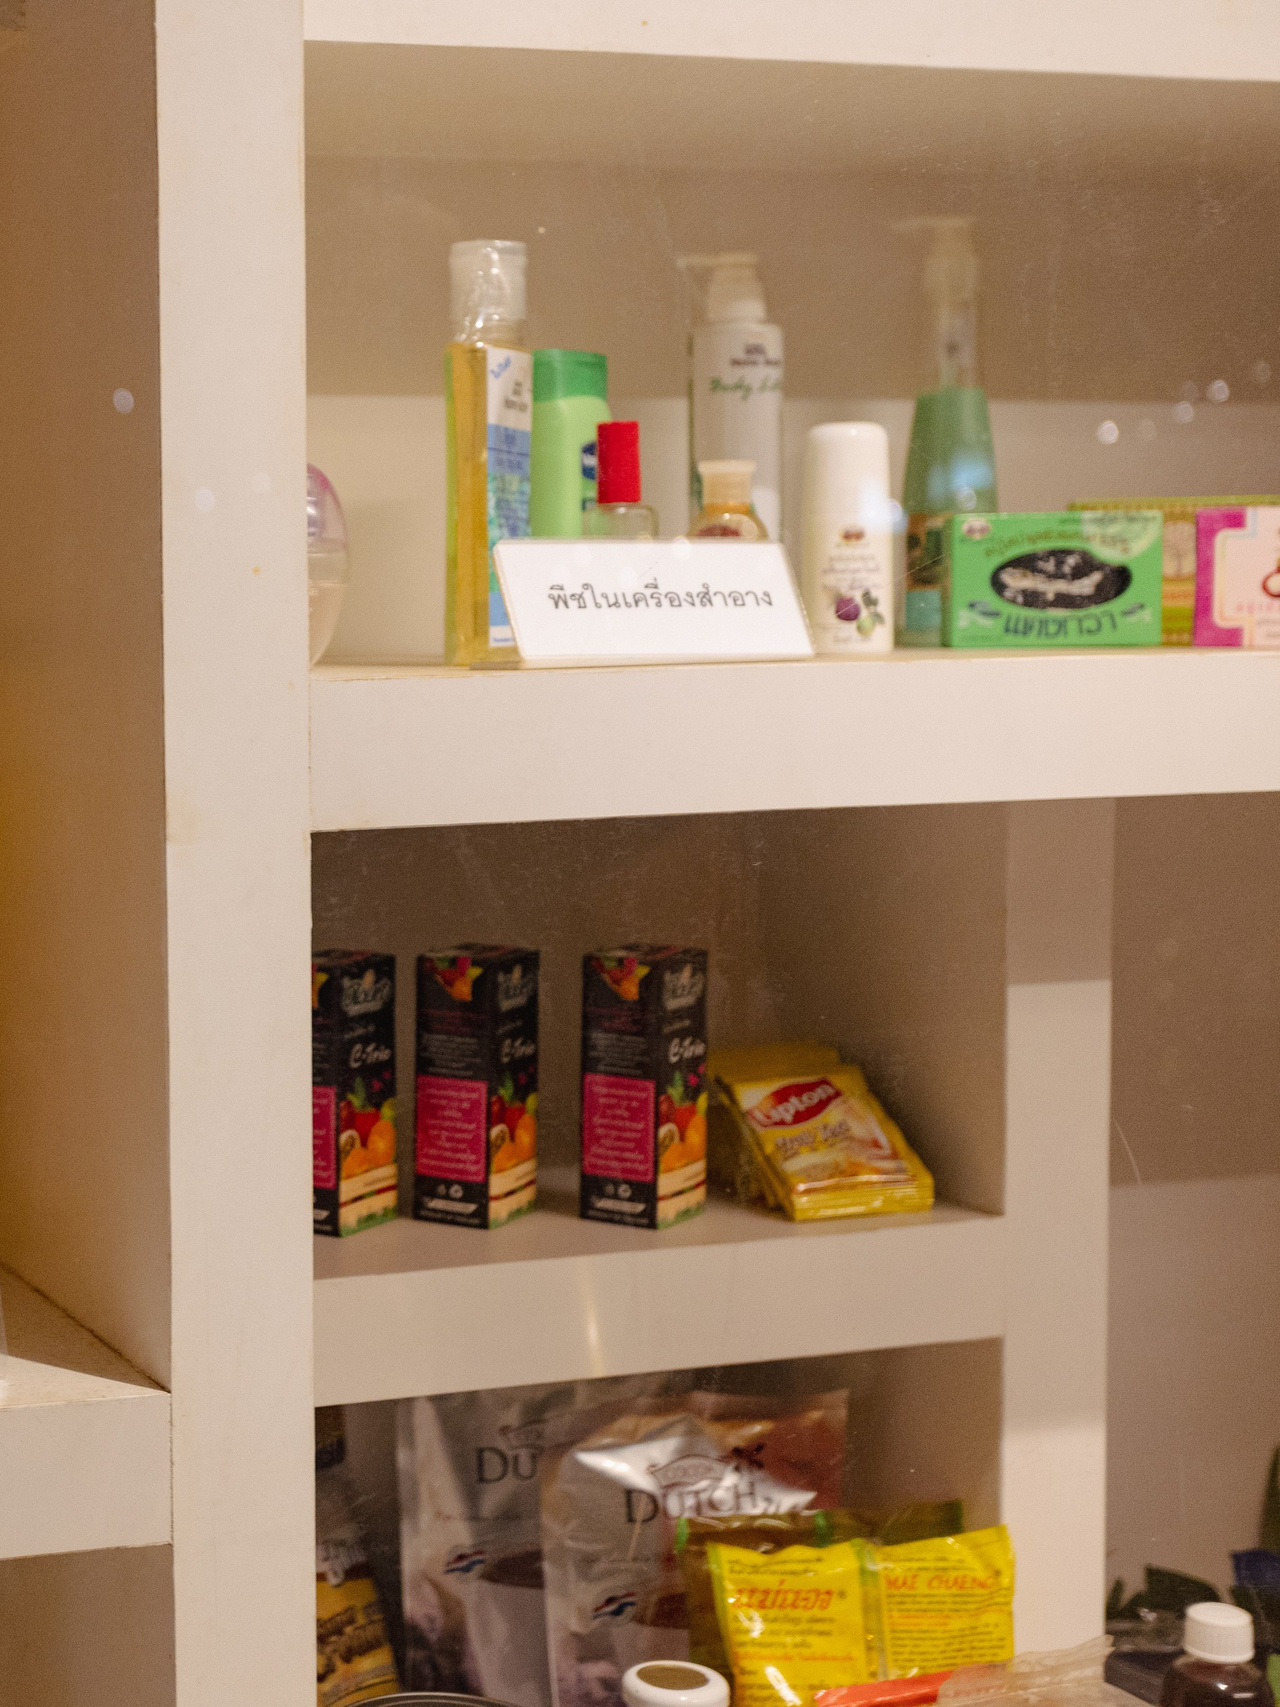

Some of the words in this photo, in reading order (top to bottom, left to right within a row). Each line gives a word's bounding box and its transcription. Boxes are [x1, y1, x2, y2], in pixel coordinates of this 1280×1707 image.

[547, 577, 774, 611] พืชในเครื่องสำอาง
[752, 1083, 836, 1128] Lipton
[624, 1480, 758, 1523] DUTCH
